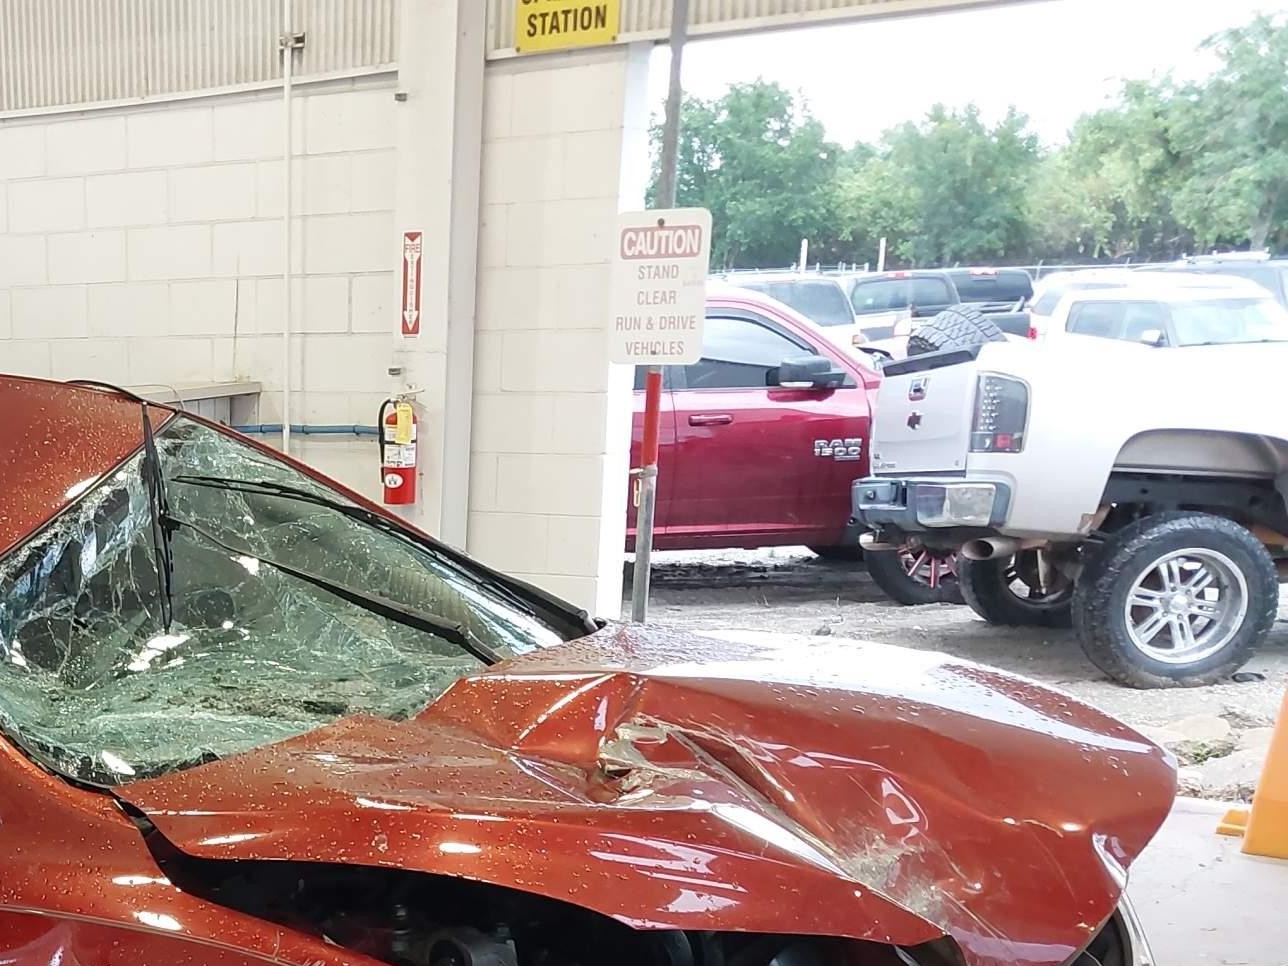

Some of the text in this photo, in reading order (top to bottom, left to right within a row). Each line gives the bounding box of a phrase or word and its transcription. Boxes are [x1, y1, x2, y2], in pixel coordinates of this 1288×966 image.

[527, 5, 607, 37] STATION
[623, 229, 700, 256] CAUTION
[638, 264, 679, 280] STAND
[637, 290, 677, 305] CLEAR
[616, 315, 697, 331] RUN & DRIVE
[625, 341, 685, 356] VEHICLES
[814, 438, 862, 449] RAM
[814, 447, 861, 456] 1500
